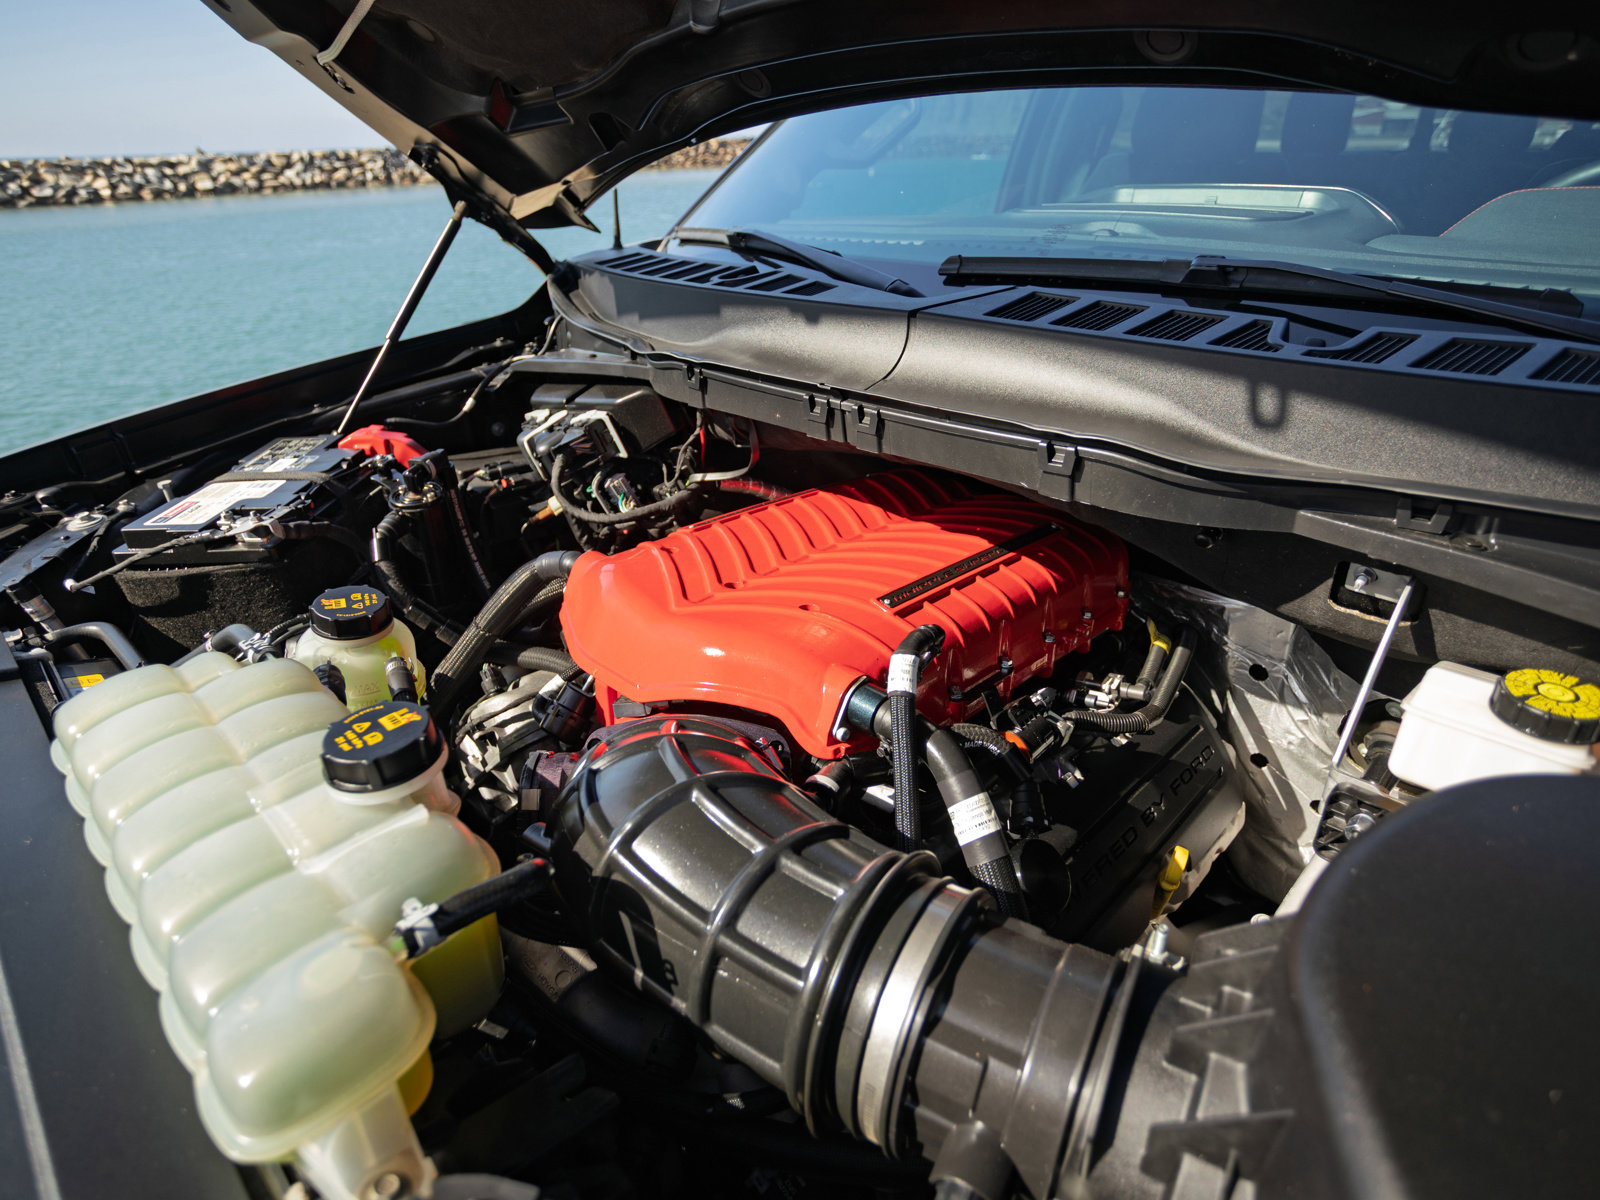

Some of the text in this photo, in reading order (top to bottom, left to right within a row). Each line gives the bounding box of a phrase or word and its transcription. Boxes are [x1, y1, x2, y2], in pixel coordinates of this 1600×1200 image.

[893, 570, 952, 602] WHIPPLE
[1140, 794, 1165, 828] BY
[1169, 745, 1215, 796] FORD
